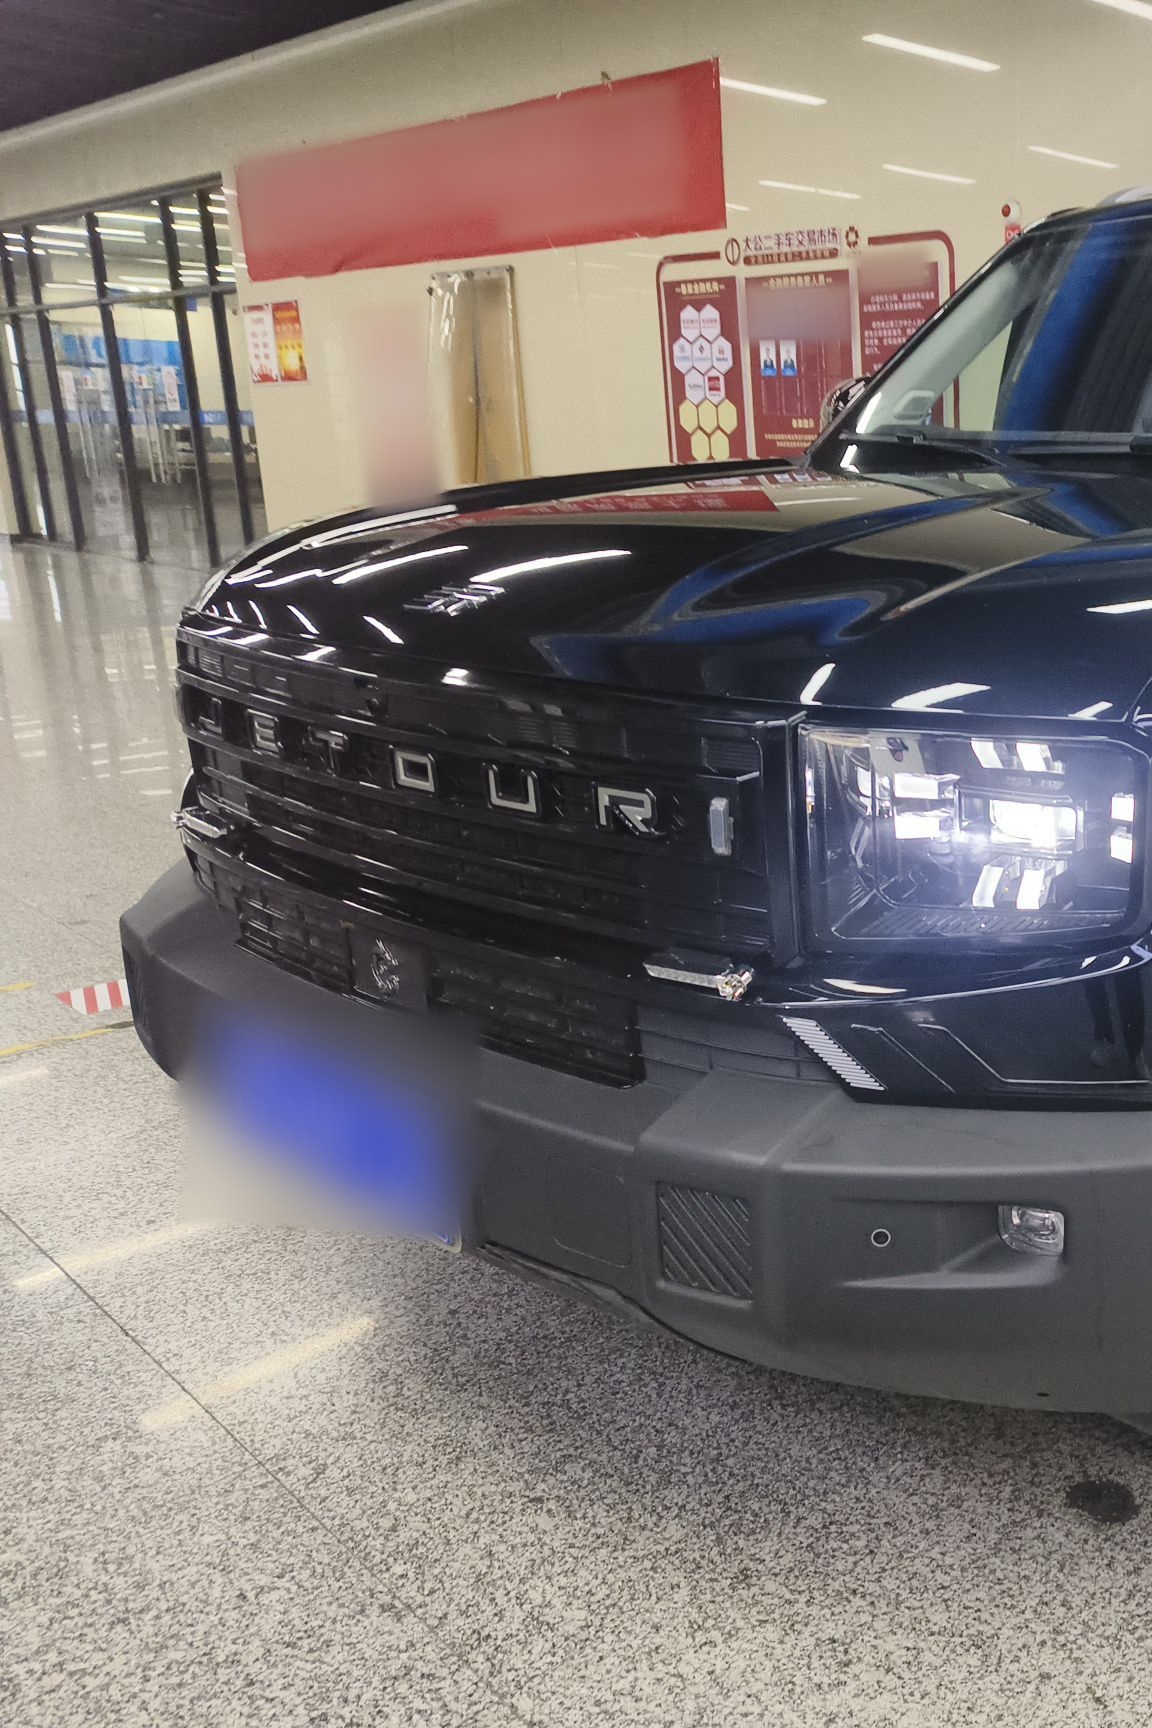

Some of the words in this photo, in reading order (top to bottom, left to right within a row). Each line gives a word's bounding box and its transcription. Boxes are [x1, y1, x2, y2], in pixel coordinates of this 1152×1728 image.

[742, 228, 838, 252] 大公二手车交易市场
[192, 697, 661, 837] JETOUR
